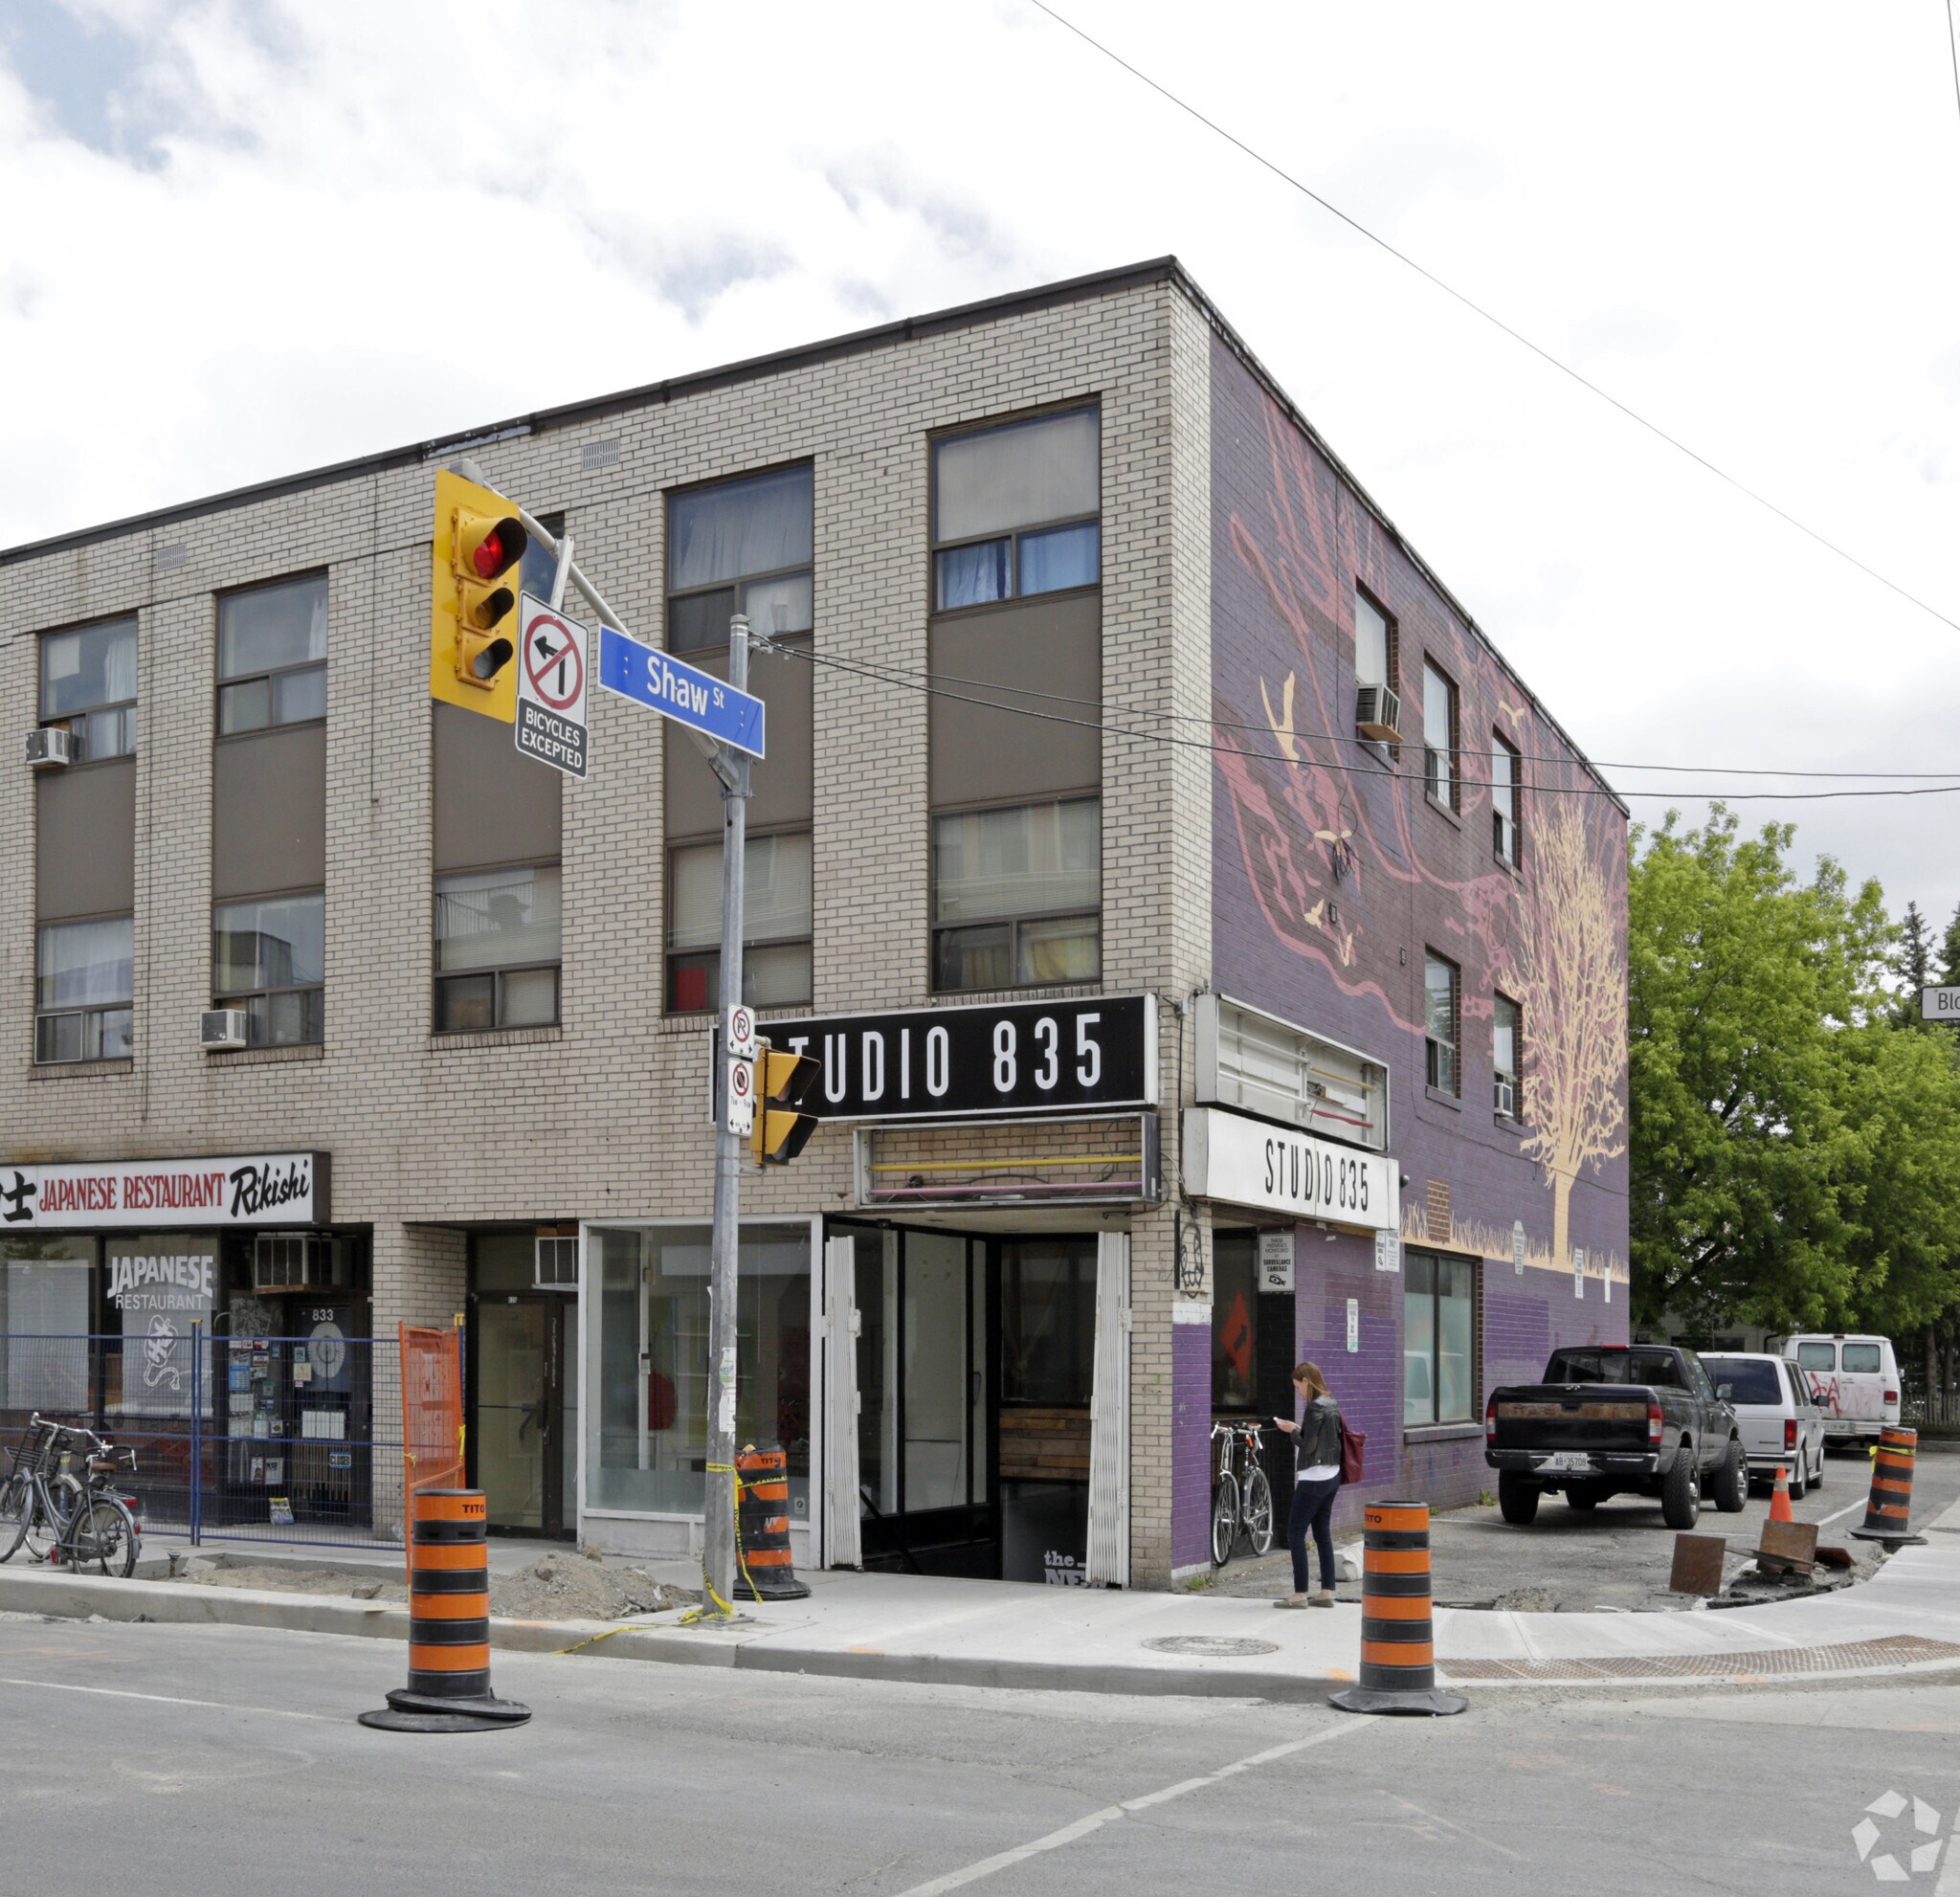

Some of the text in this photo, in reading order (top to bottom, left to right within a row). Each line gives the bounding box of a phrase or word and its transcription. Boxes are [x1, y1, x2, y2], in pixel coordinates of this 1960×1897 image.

[647, 656, 724, 716] Shaw St
[522, 726, 582, 769] EXCEPTED
[525, 706, 580, 747] BICYCLES
[752, 1013, 1101, 1104] TUDIO 835
[39, 1159, 310, 1217] JAPANESE RESTAURANT Rikishi
[1265, 1138, 1369, 1212] STUDIO 835
[107, 1255, 213, 1299] JAPANESE
[116, 1294, 204, 1309] RESTAURANT
[312, 1309, 334, 1321] 833
[462, 1504, 485, 1514] TITO
[1044, 1550, 1075, 1568] the
